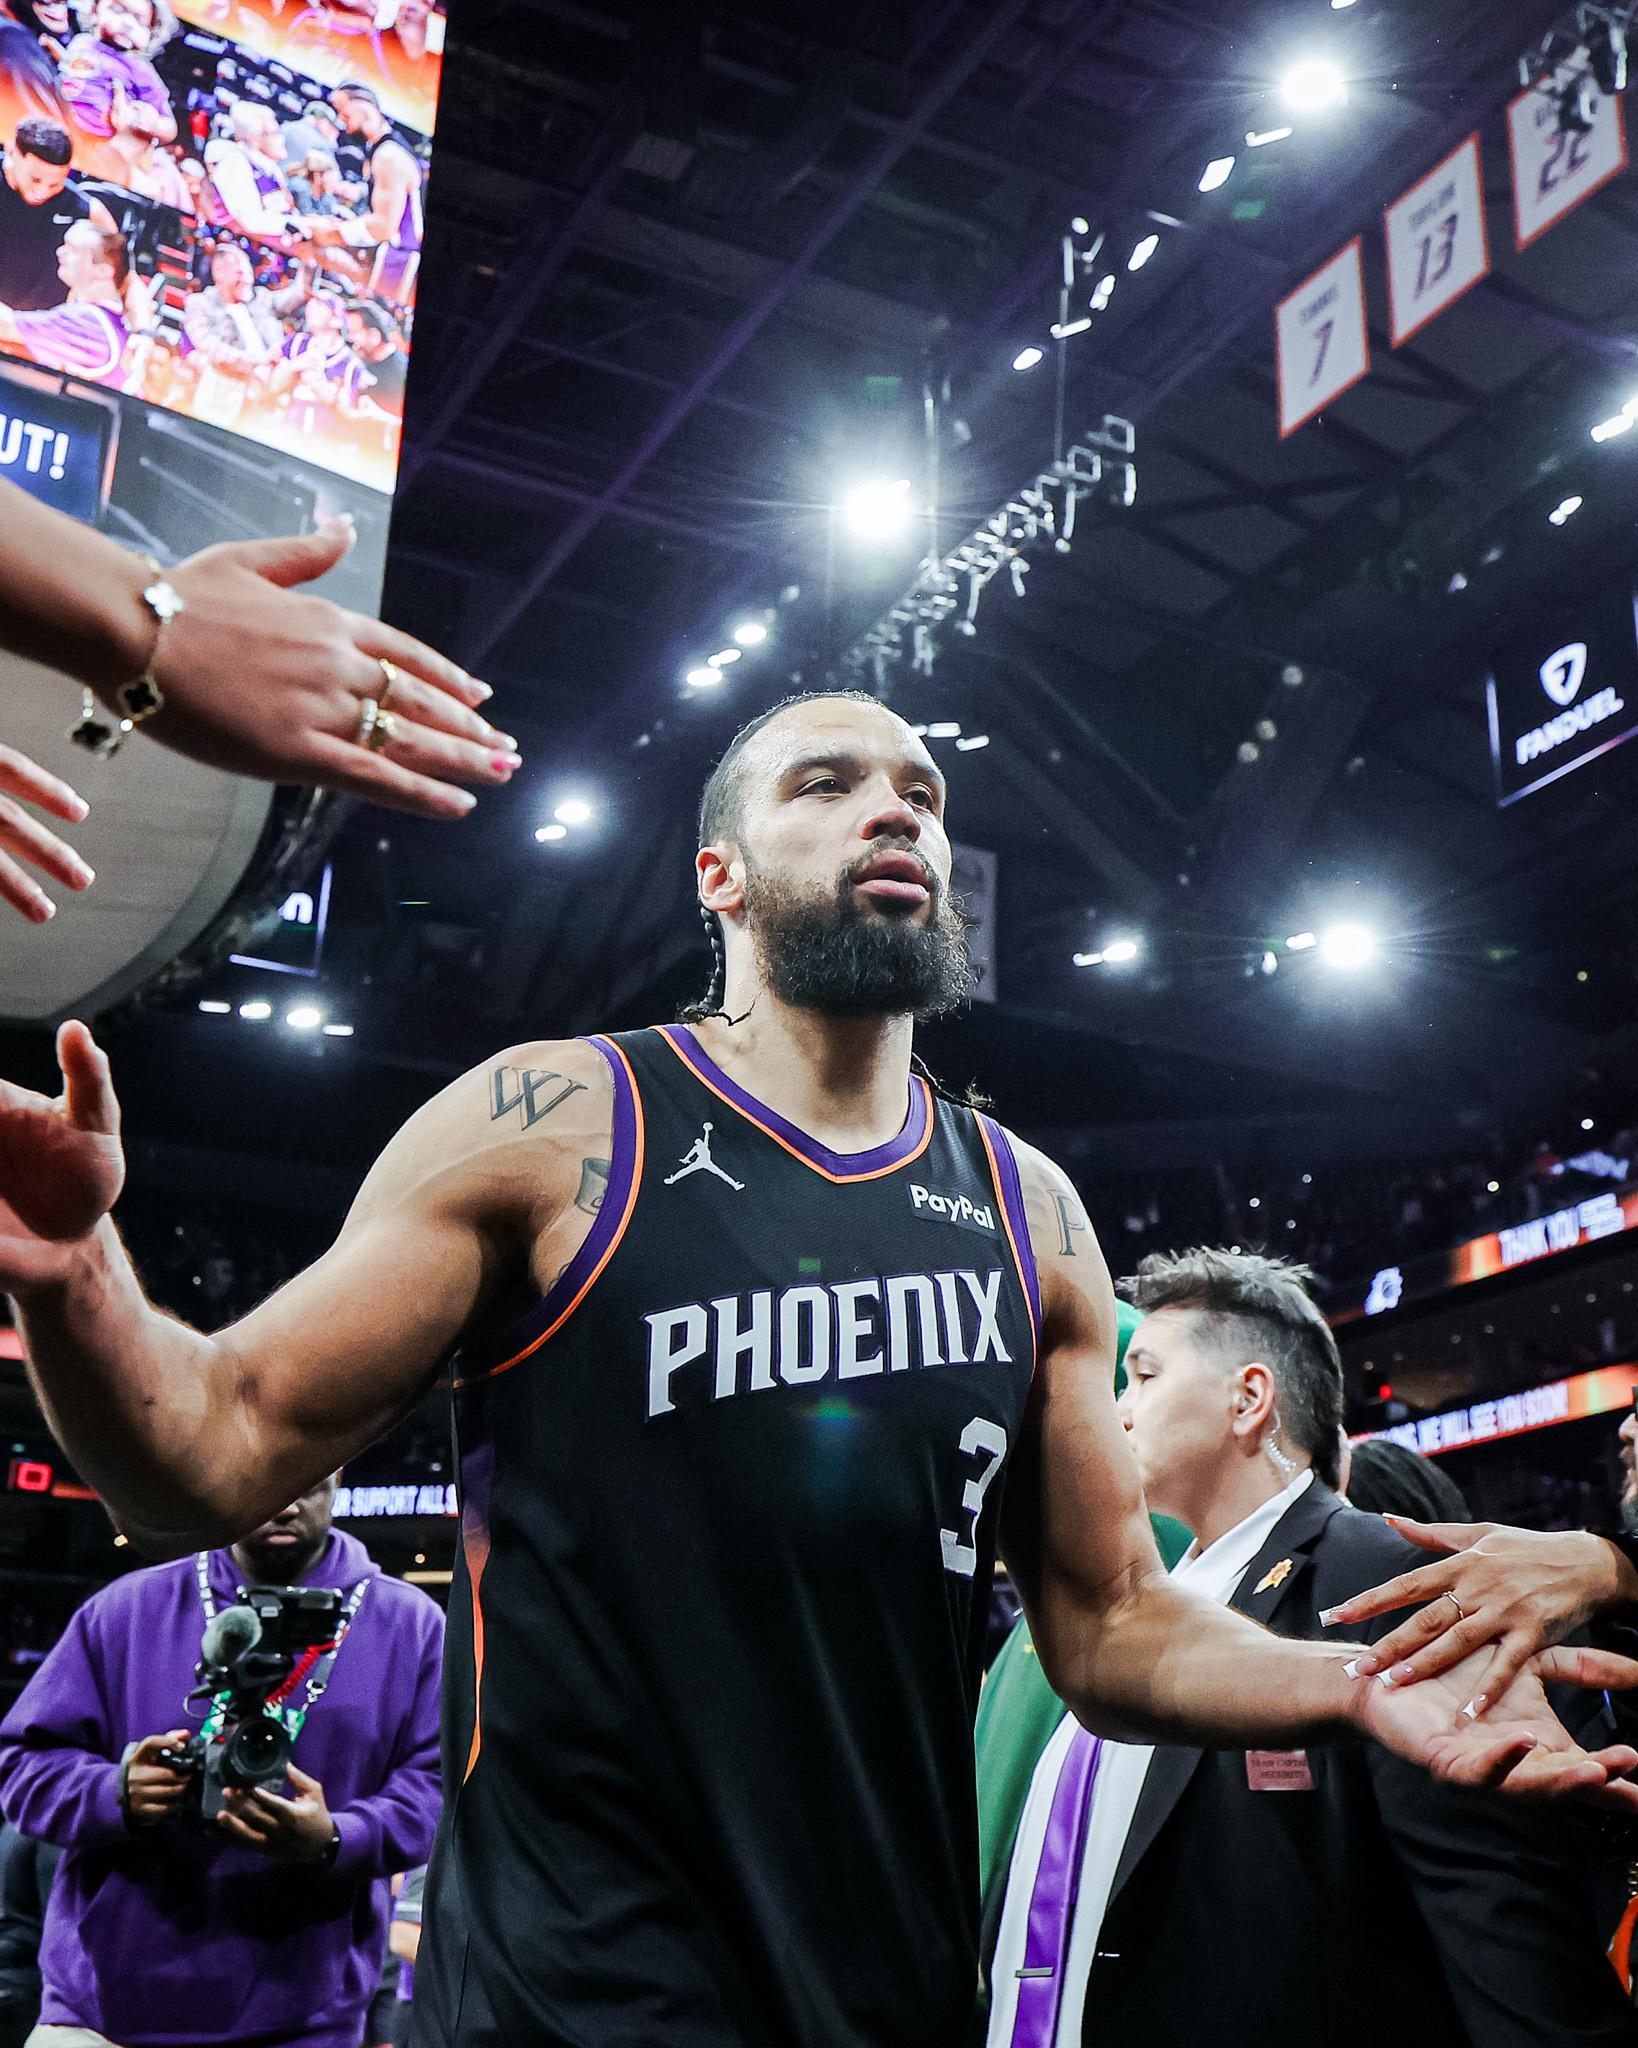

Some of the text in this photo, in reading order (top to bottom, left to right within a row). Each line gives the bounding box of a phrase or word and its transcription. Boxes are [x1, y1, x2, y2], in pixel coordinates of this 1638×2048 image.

[1413, 212, 1460, 300] 13
[1309, 317, 1335, 388] 7
[909, 1183, 996, 1231] PayPal
[641, 1268, 1014, 1420] PHOENIX
[940, 1416, 1007, 1579] 3
